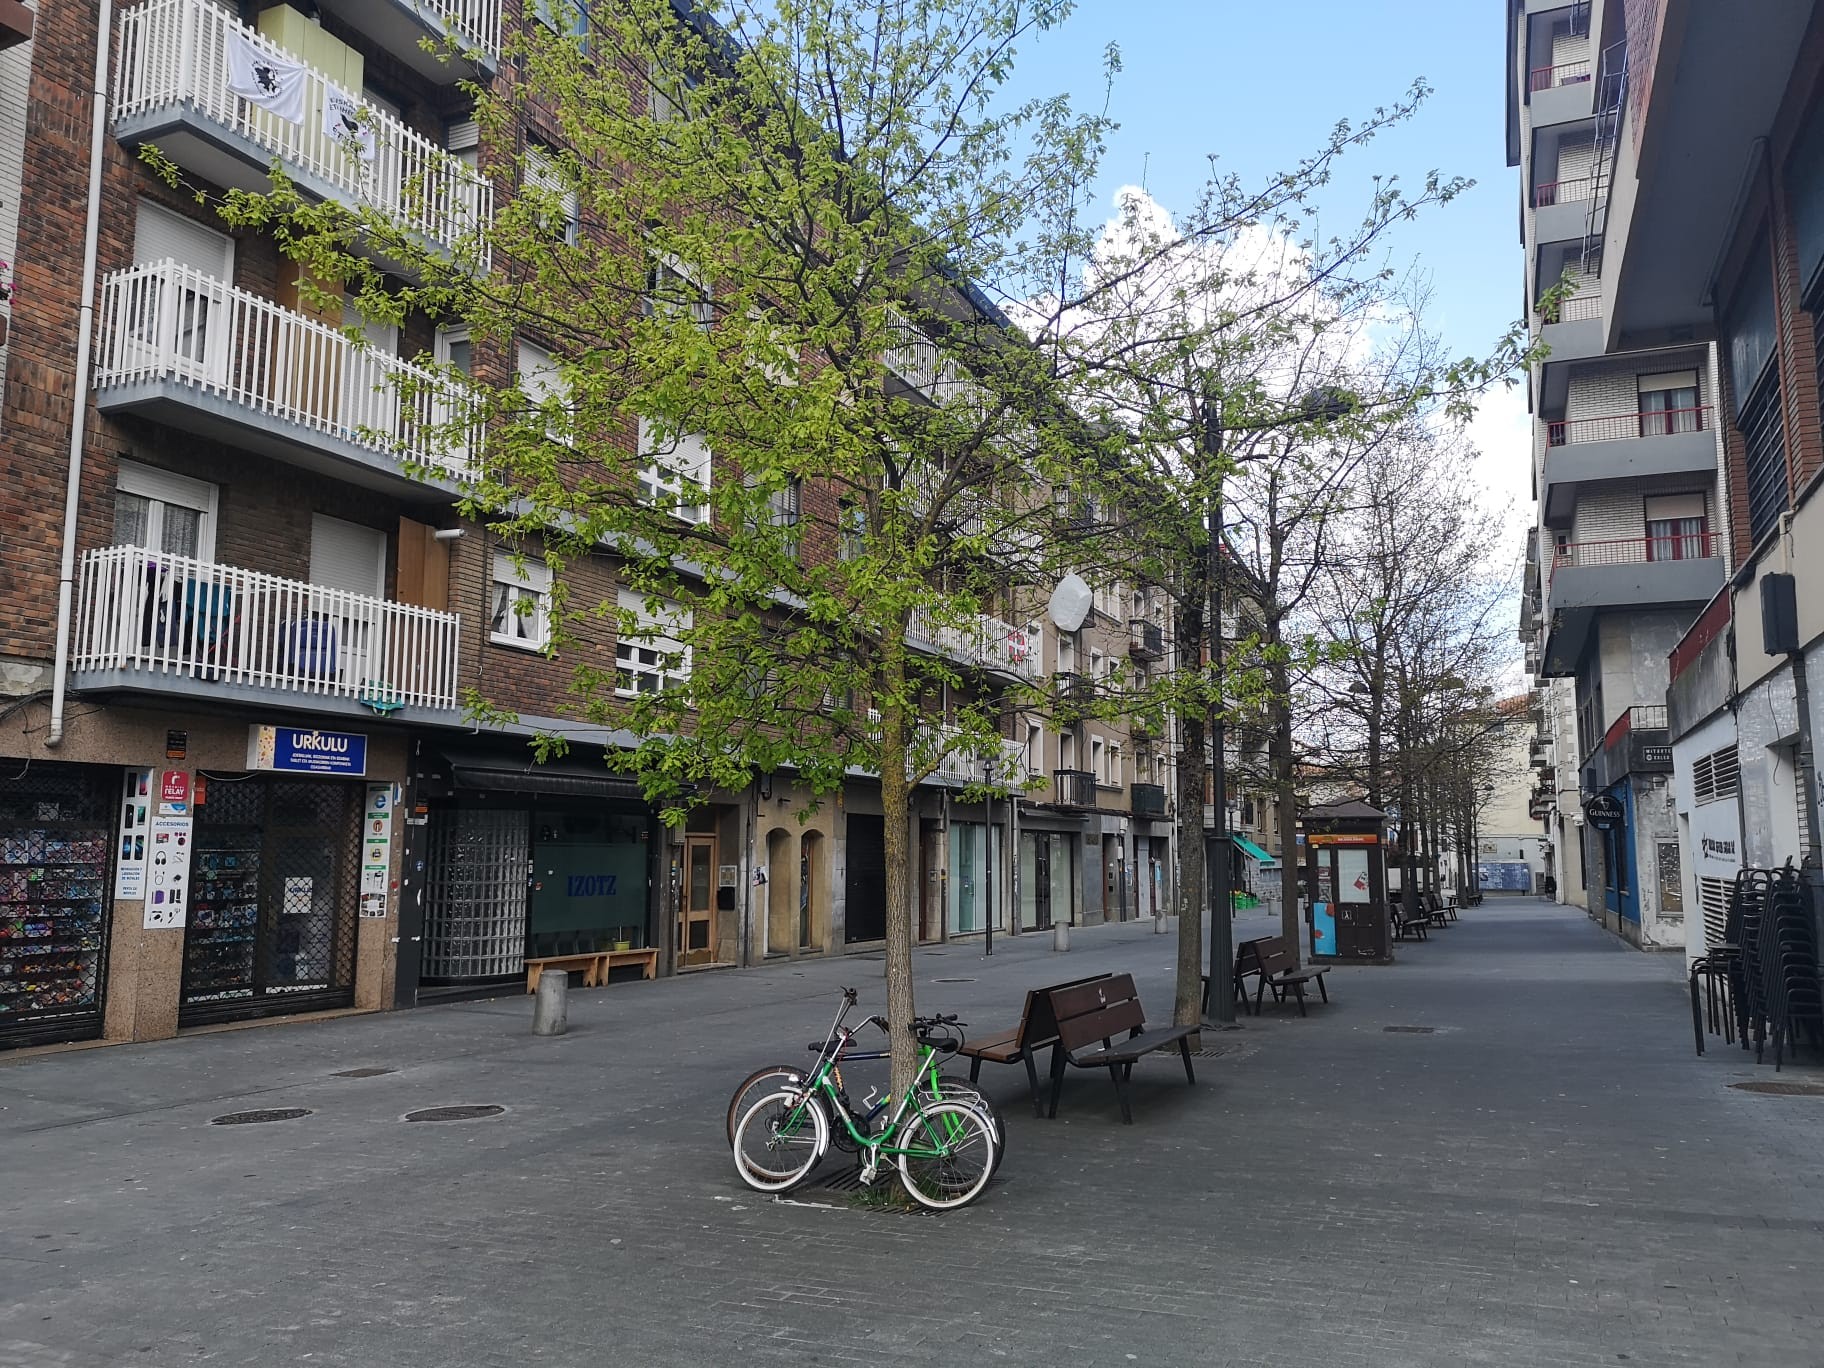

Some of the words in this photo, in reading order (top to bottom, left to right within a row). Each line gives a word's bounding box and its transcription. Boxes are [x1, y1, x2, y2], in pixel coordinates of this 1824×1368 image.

[292, 733, 348, 753] URKULU
[1589, 809, 1620, 817] GUINNESS
[567, 875, 617, 897] IZOTZ
